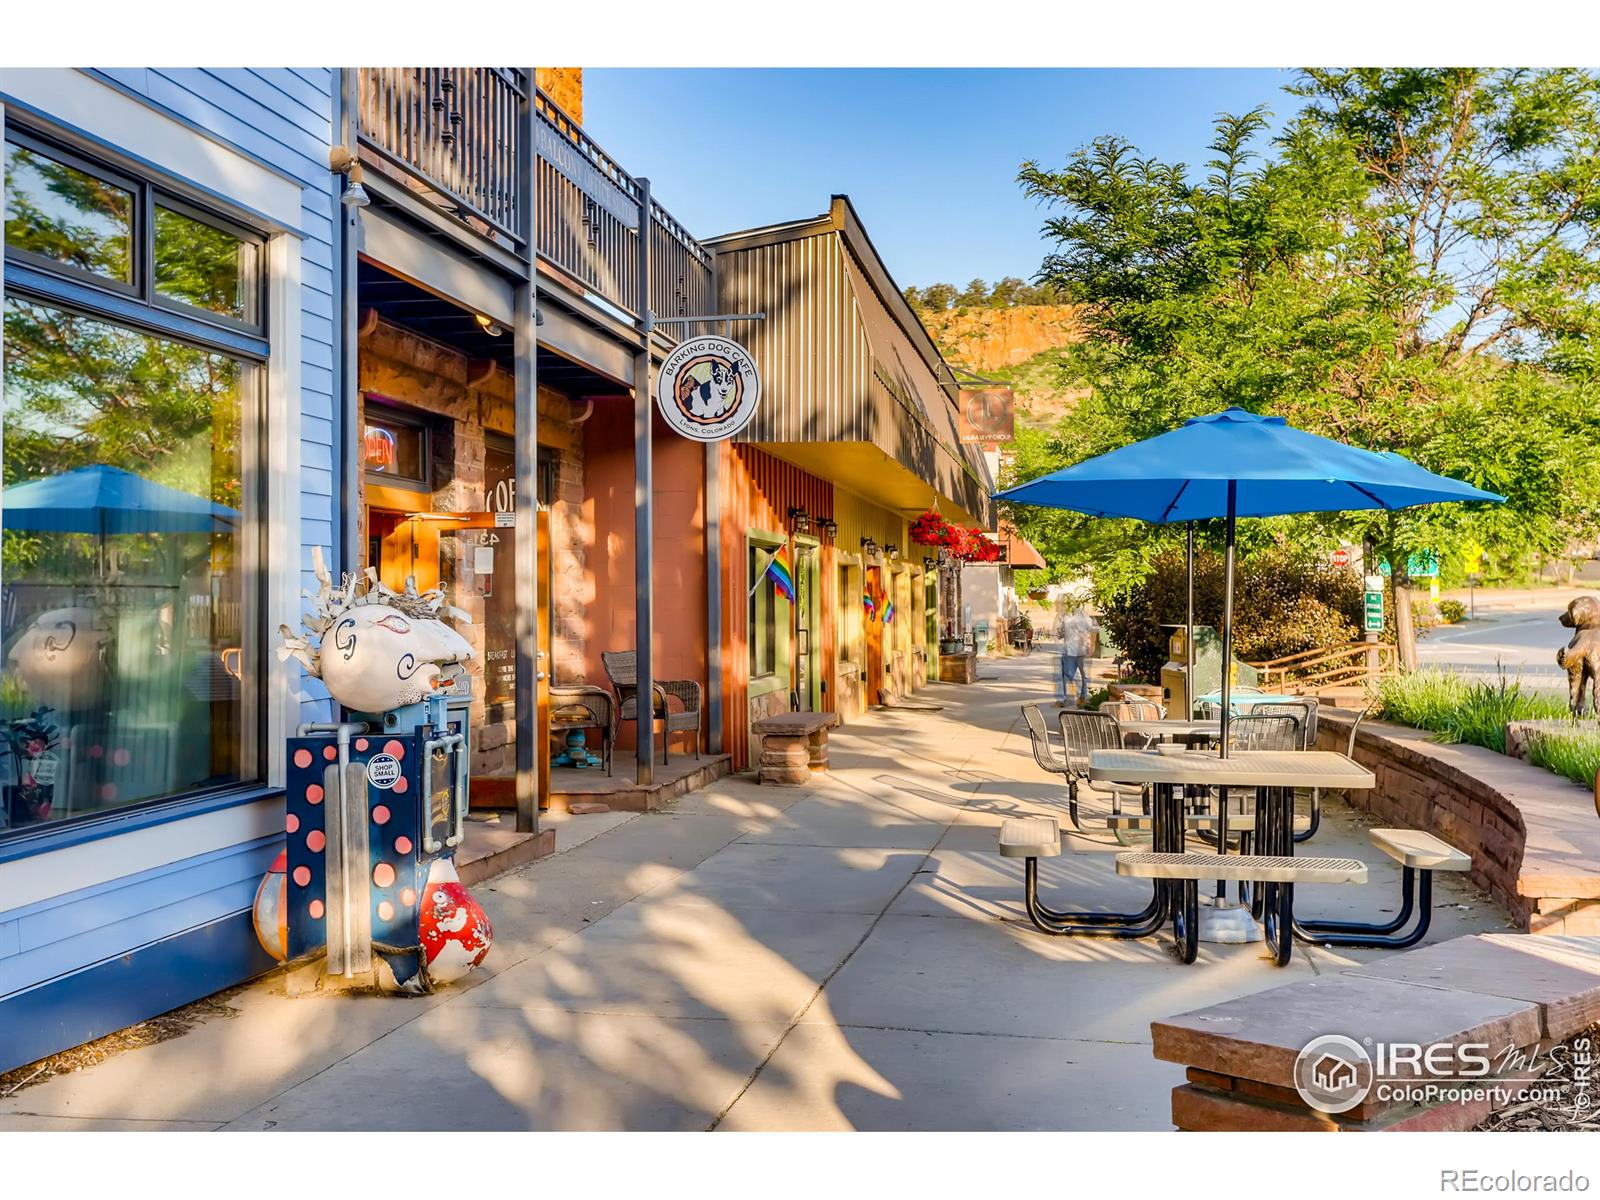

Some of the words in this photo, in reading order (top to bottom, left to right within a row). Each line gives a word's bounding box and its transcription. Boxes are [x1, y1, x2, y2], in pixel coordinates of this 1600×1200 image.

[540, 127, 581, 182] BALCONY
[666, 343, 706, 376] BARKING
[708, 342, 731, 355] DOG
[731, 351, 753, 377] CAFE
[1332, 554, 1349, 562] STOP
